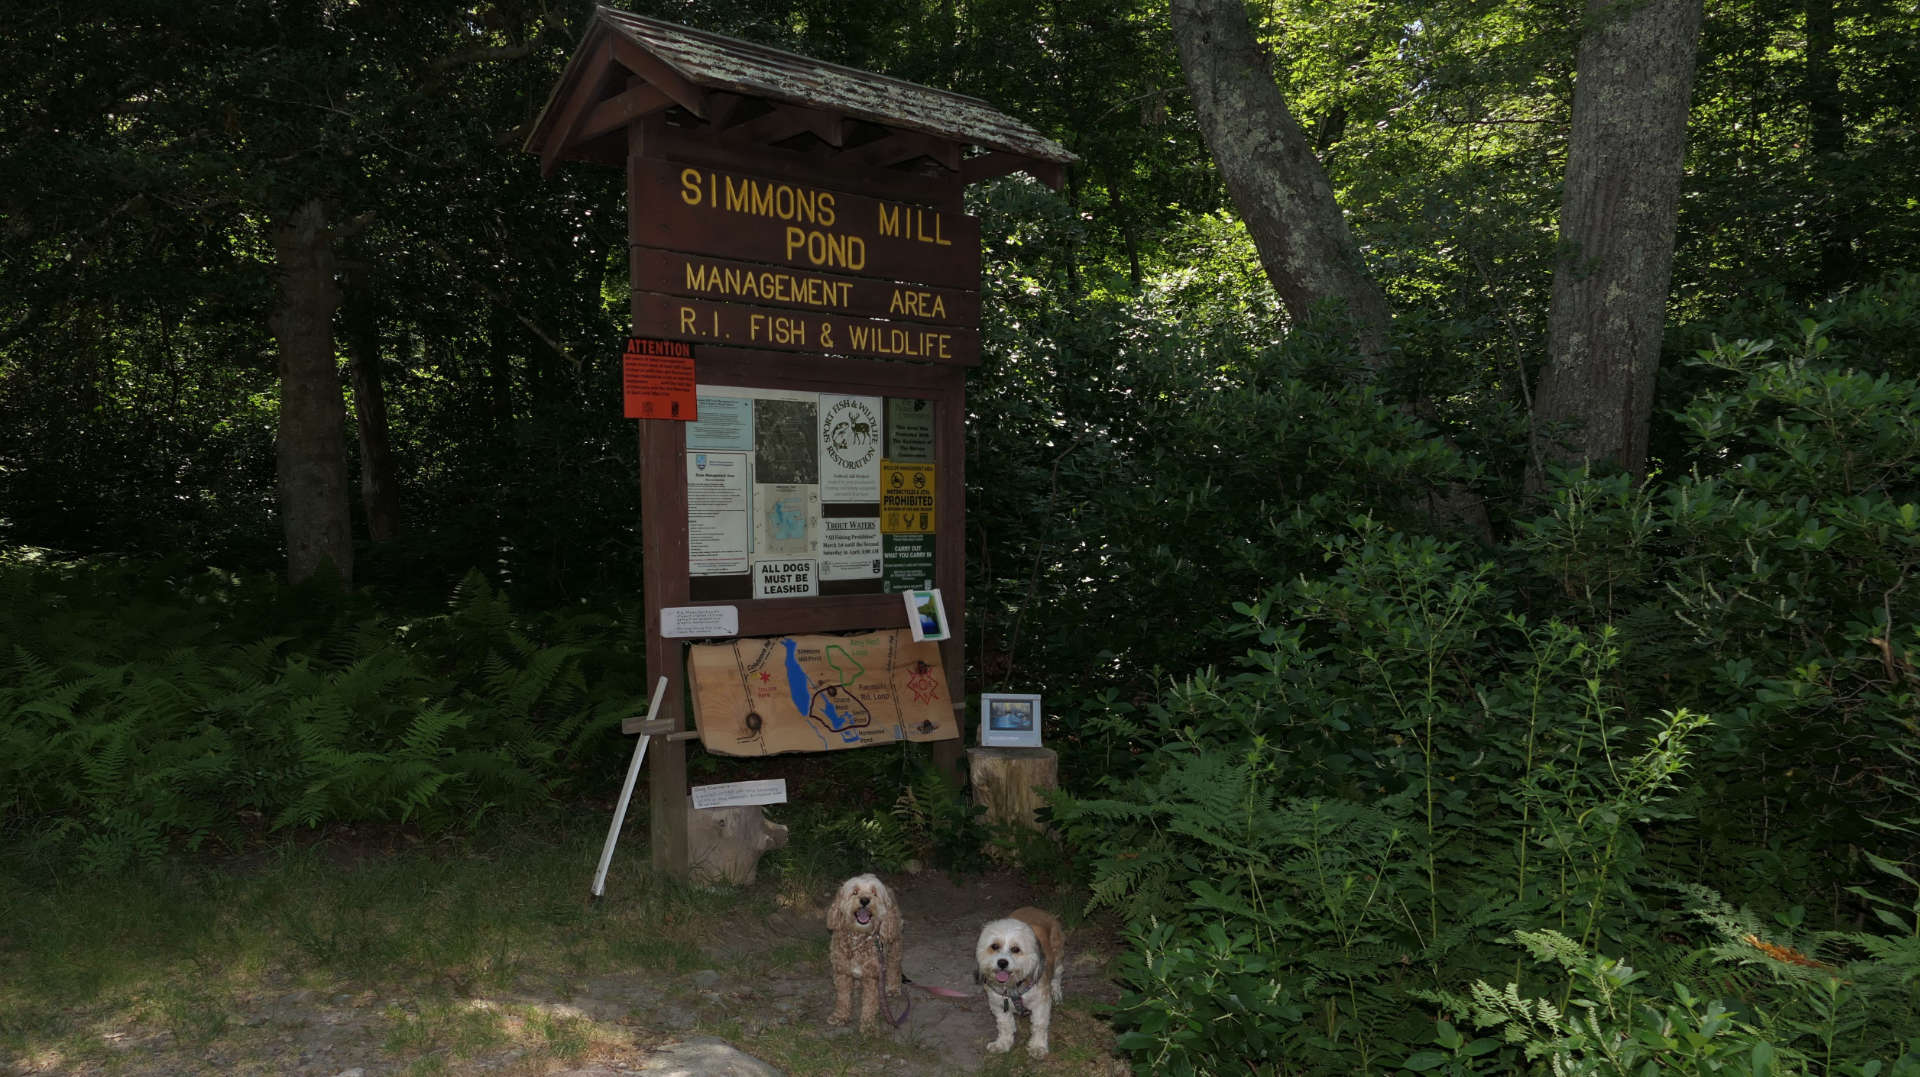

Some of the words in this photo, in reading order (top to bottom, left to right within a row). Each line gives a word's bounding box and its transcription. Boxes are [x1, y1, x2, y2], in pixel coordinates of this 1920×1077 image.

[680, 168, 836, 226] SIMMONS
[879, 202, 952, 246] MILL
[786, 226, 866, 271] POND
[686, 262, 854, 308] MANAGEMENT
[889, 289, 947, 320] AREA
[680, 307, 731, 340] R.I.
[750, 314, 806, 345] FISH
[820, 322, 834, 348] &
[849, 324, 952, 359] WILDLIFE
[627, 338, 690, 357] ATTENTION
[824, 411, 834, 443] SPORT
[832, 399, 850, 414] FISH
[851, 399, 858, 409] &
[858, 402, 879, 445] WILDLIFE
[826, 445, 876, 470] RESTORATION
[884, 495, 933, 506] PROHIBITED
[761, 564, 780, 574] ALL
[783, 563, 810, 573] DOGS
[764, 575, 792, 584] MUST
[795, 573, 808, 582] BE
[764, 584, 809, 594] LEASHED
